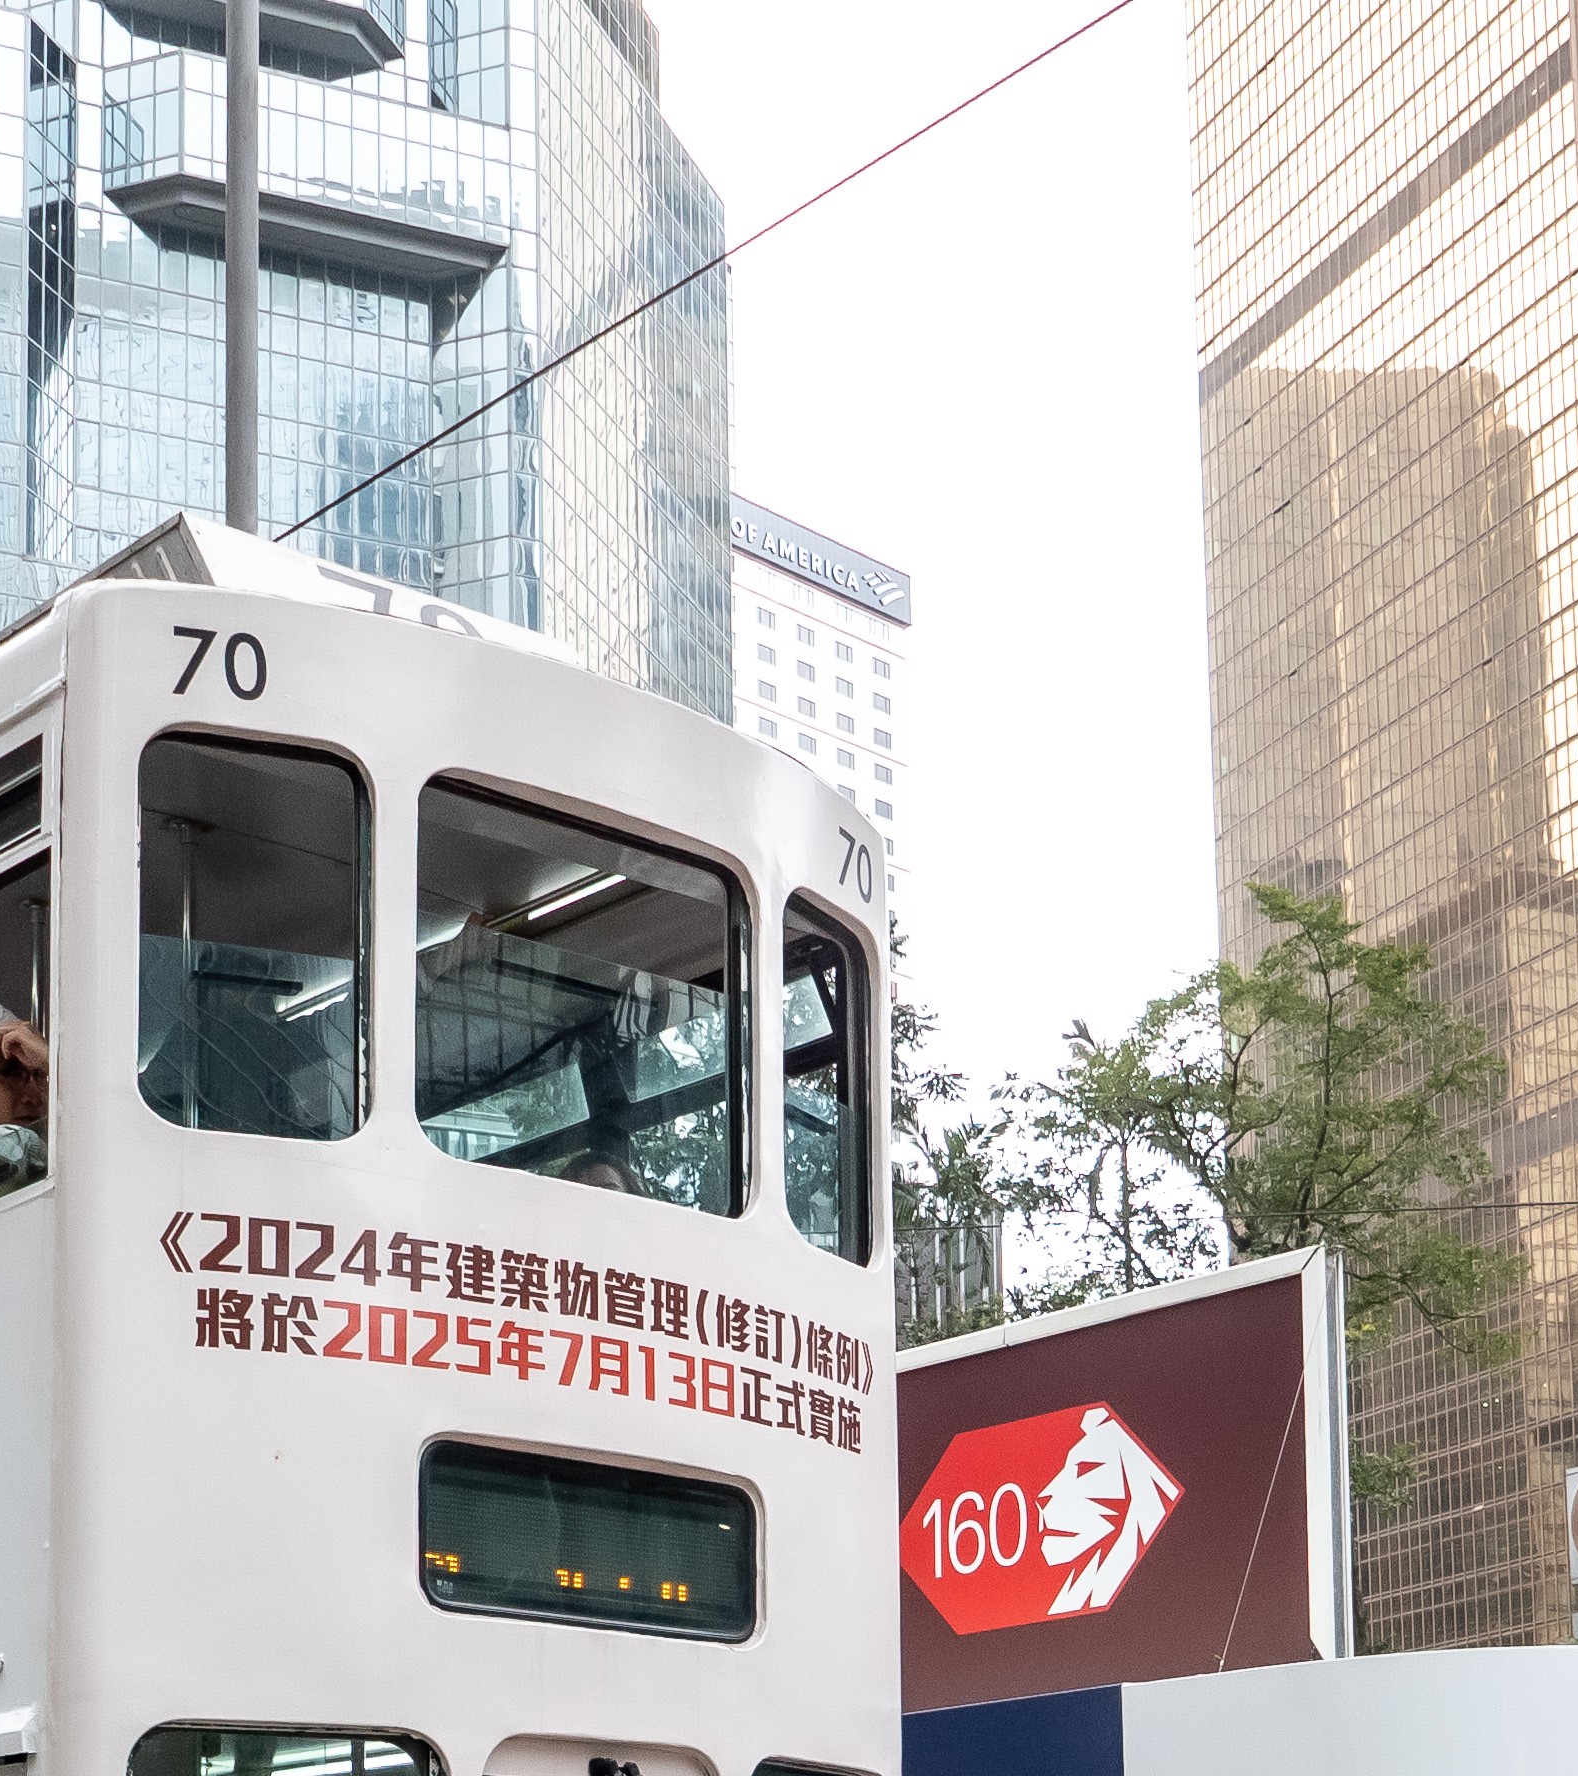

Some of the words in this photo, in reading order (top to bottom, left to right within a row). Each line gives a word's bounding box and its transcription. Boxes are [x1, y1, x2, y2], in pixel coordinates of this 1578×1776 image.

[731, 516, 758, 543] OF
[762, 531, 859, 592] AMERICA
[173, 626, 268, 701] 70
[838, 827, 872, 903] 70
[160, 1211, 875, 1395] 《2024年建築物管理（修訂）條例》
[195, 1288, 862, 1456] 將於2025年7月13日正式實施
[922, 1482, 1028, 1579] 160
